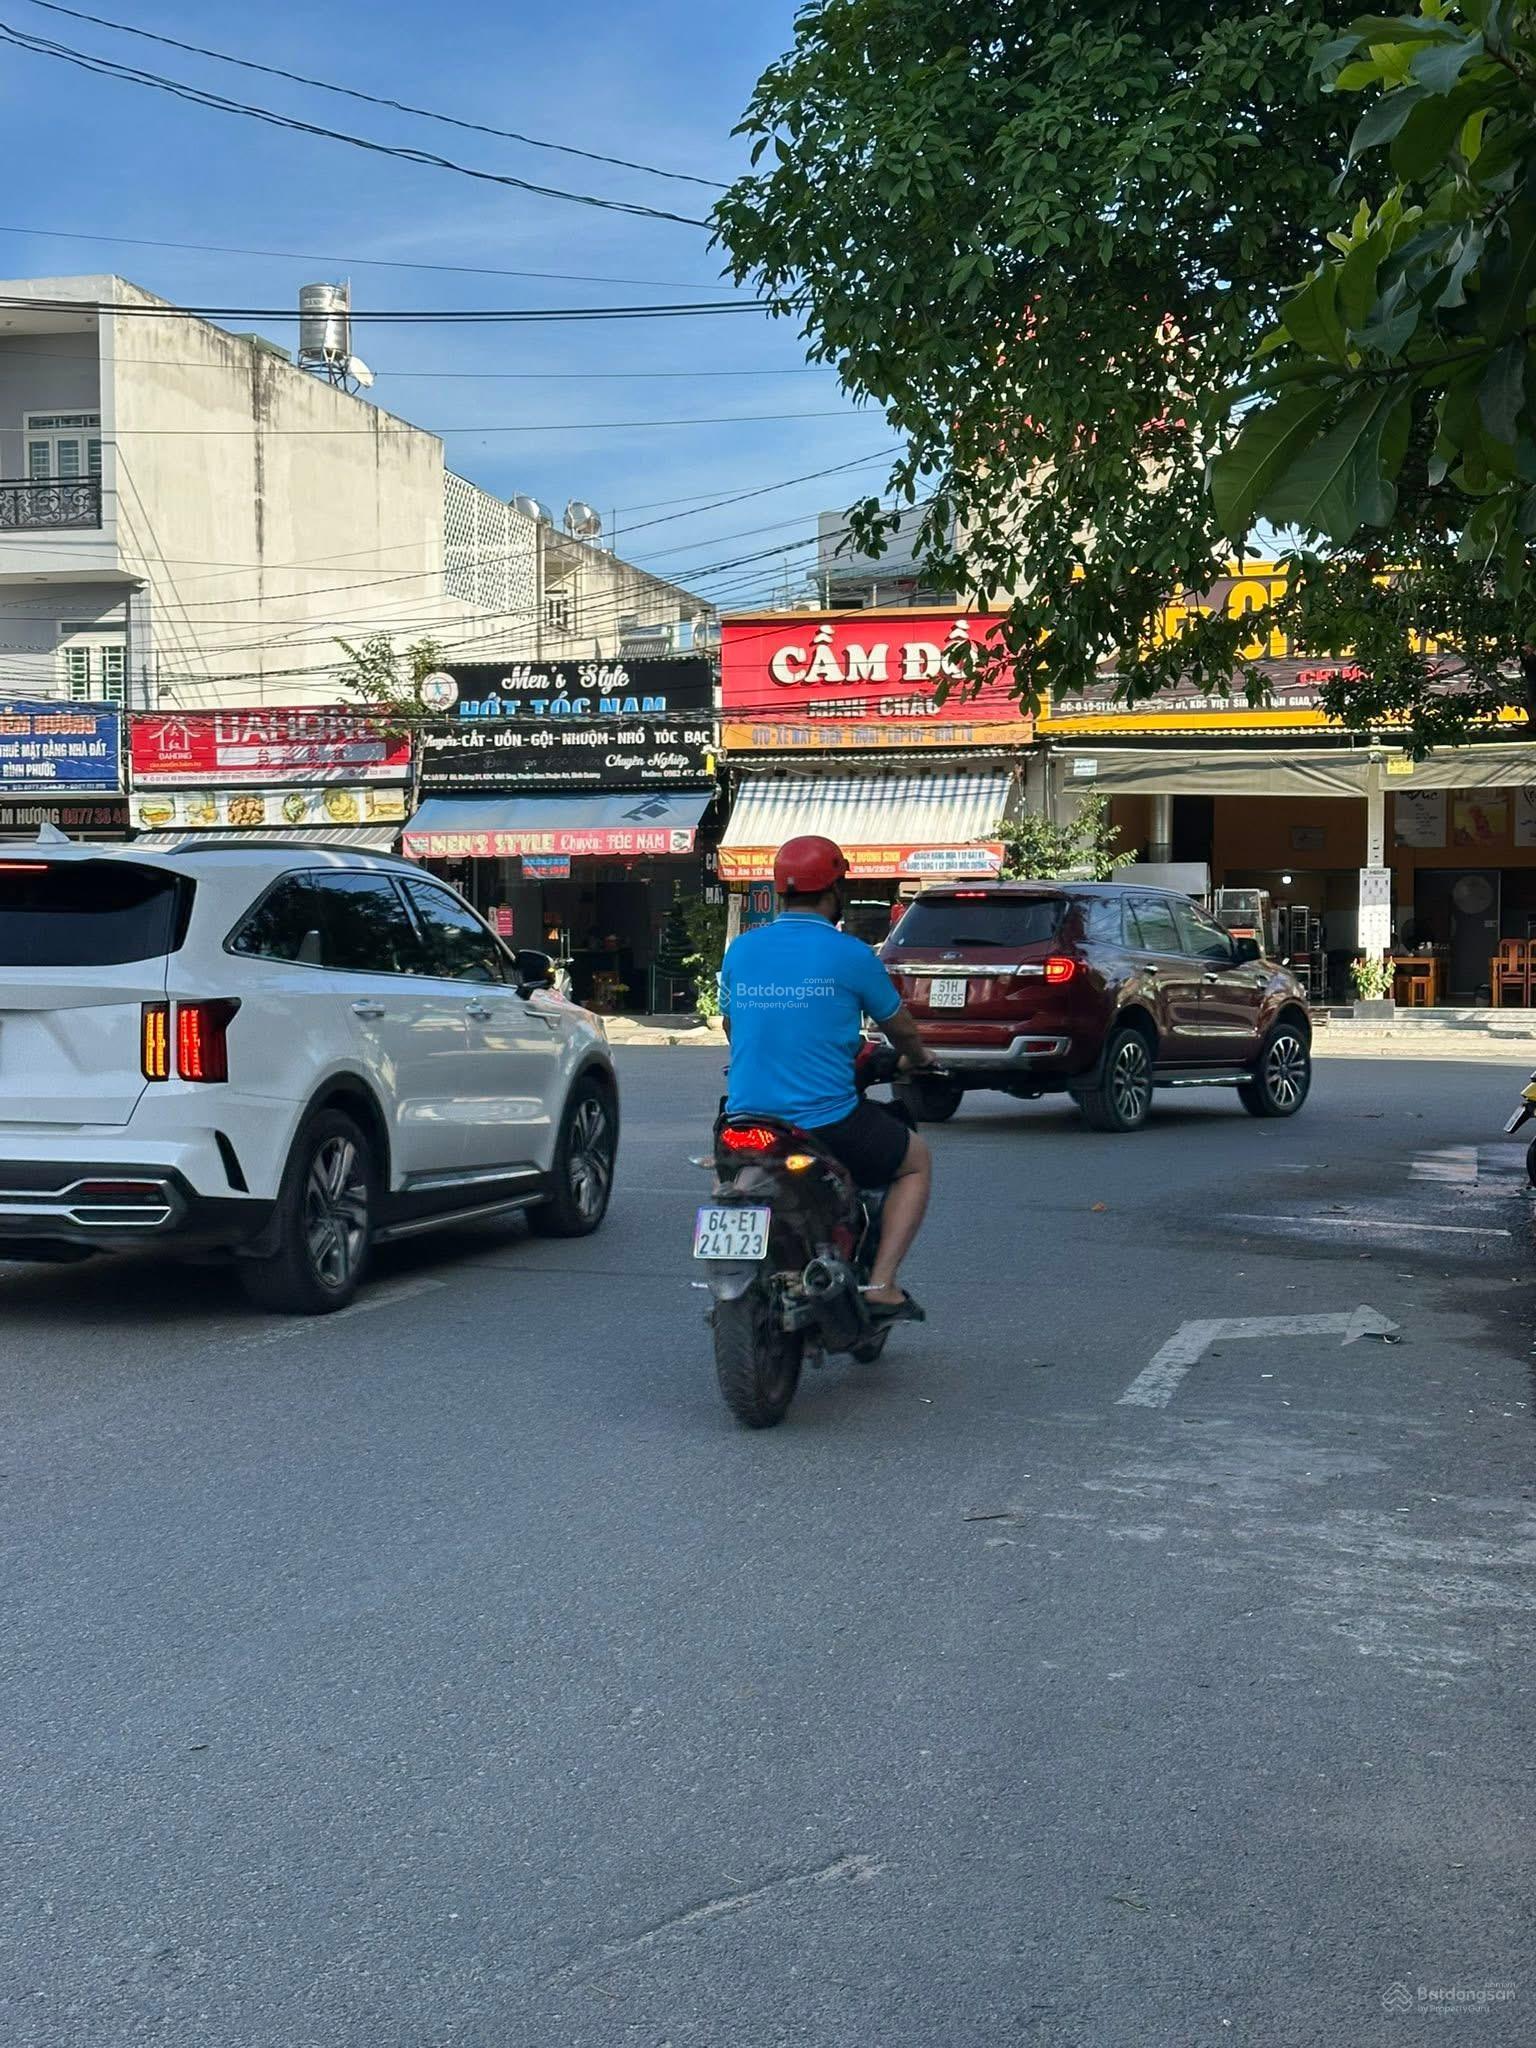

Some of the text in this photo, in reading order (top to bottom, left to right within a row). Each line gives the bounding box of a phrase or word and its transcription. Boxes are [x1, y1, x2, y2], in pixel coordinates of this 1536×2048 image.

[769, 624, 888, 685] CẦM
[578, 663, 631, 695] Style
[529, 690, 592, 717] TÓC
[598, 696, 667, 716] NAM
[1211, 699, 1230, 712] VIỆT
[654, 729, 678, 744] TÓC
[684, 731, 710, 746] BẠC
[26, 760, 57, 777] PHƯỚC
[647, 752, 690, 768] Nghiệp
[17, 806, 60, 825] HƯƠNG
[494, 833, 555, 853] STYLE
[636, 833, 665, 850] NAM
[939, 980, 958, 993] 51H
[708, 1211, 758, 1232] 64-E1
[699, 1234, 763, 1255] 241.23
